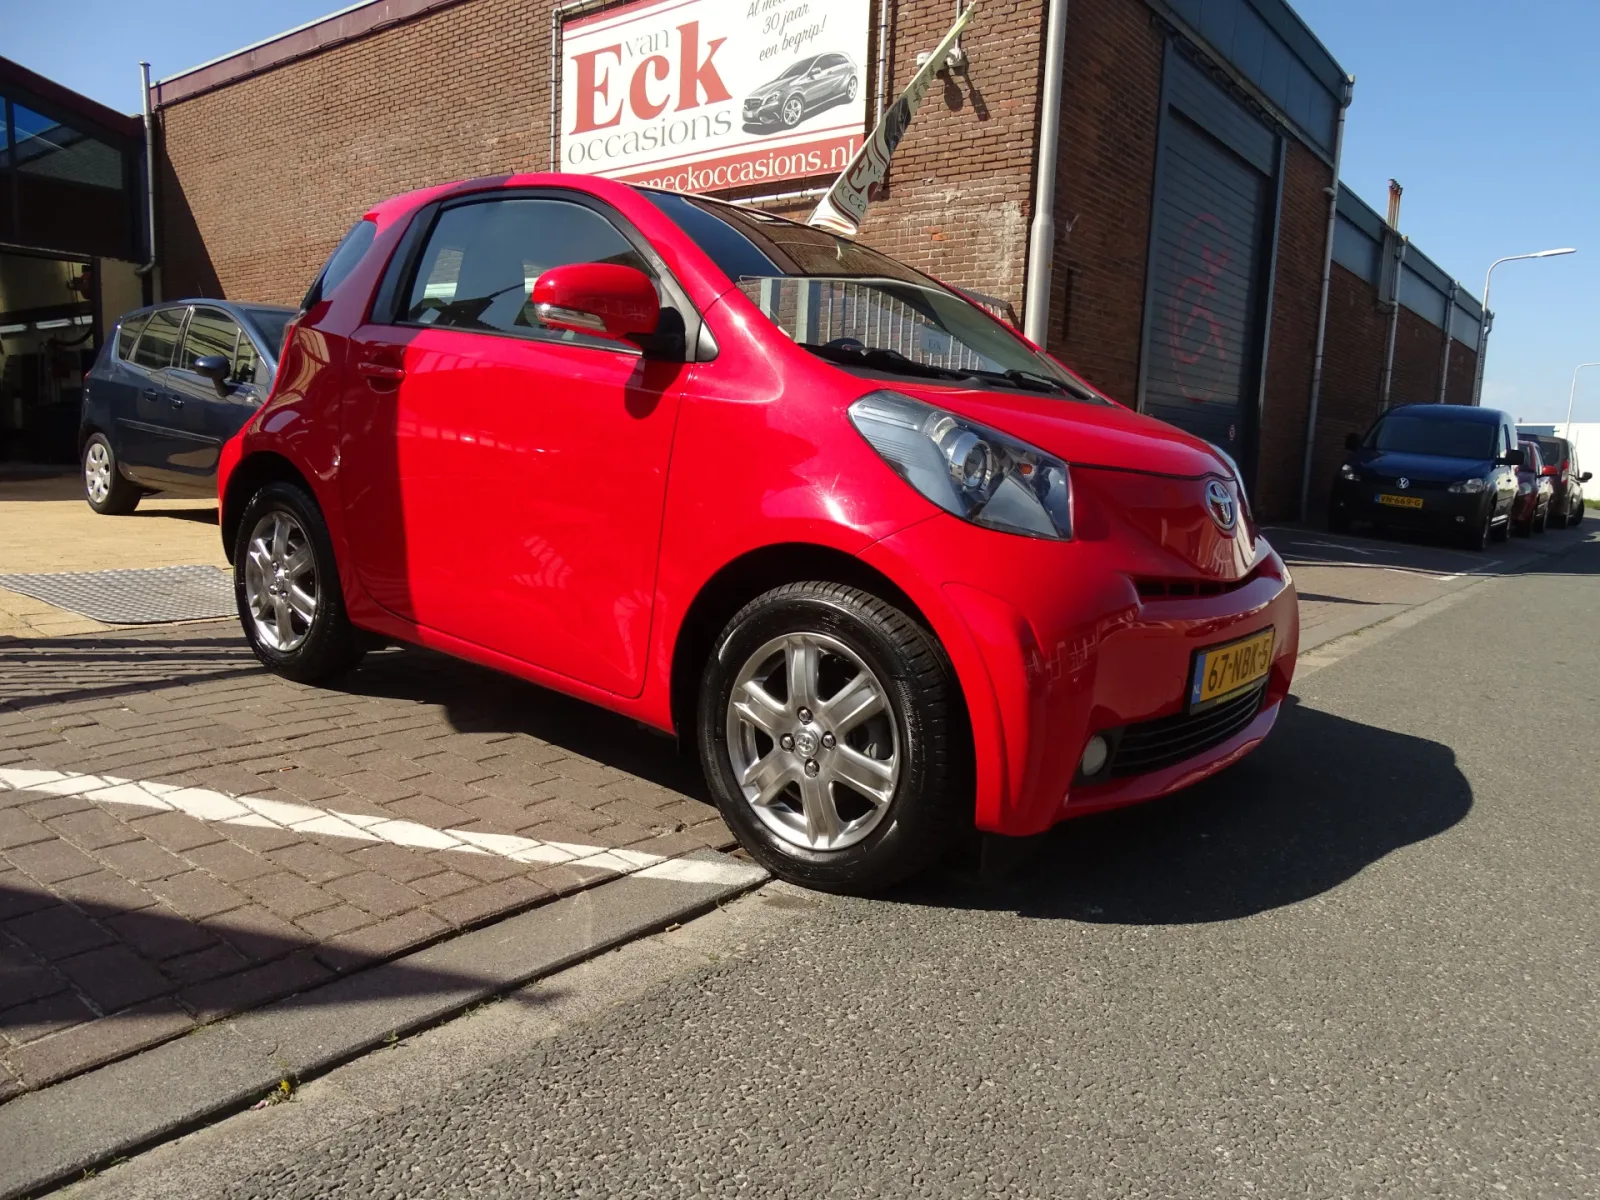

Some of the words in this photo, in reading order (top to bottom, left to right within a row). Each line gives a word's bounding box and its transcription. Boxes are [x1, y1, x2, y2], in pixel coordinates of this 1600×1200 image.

[626, 29, 669, 57] van
[759, 44, 778, 61] een
[782, 14, 827, 54] begrip!
[763, 12, 780, 34] 30
[779, 3, 809, 36] jaar
[568, 20, 733, 135] Eck
[568, 110, 732, 165] occasions
[1208, 639, 1270, 692] 67-NBK-5
